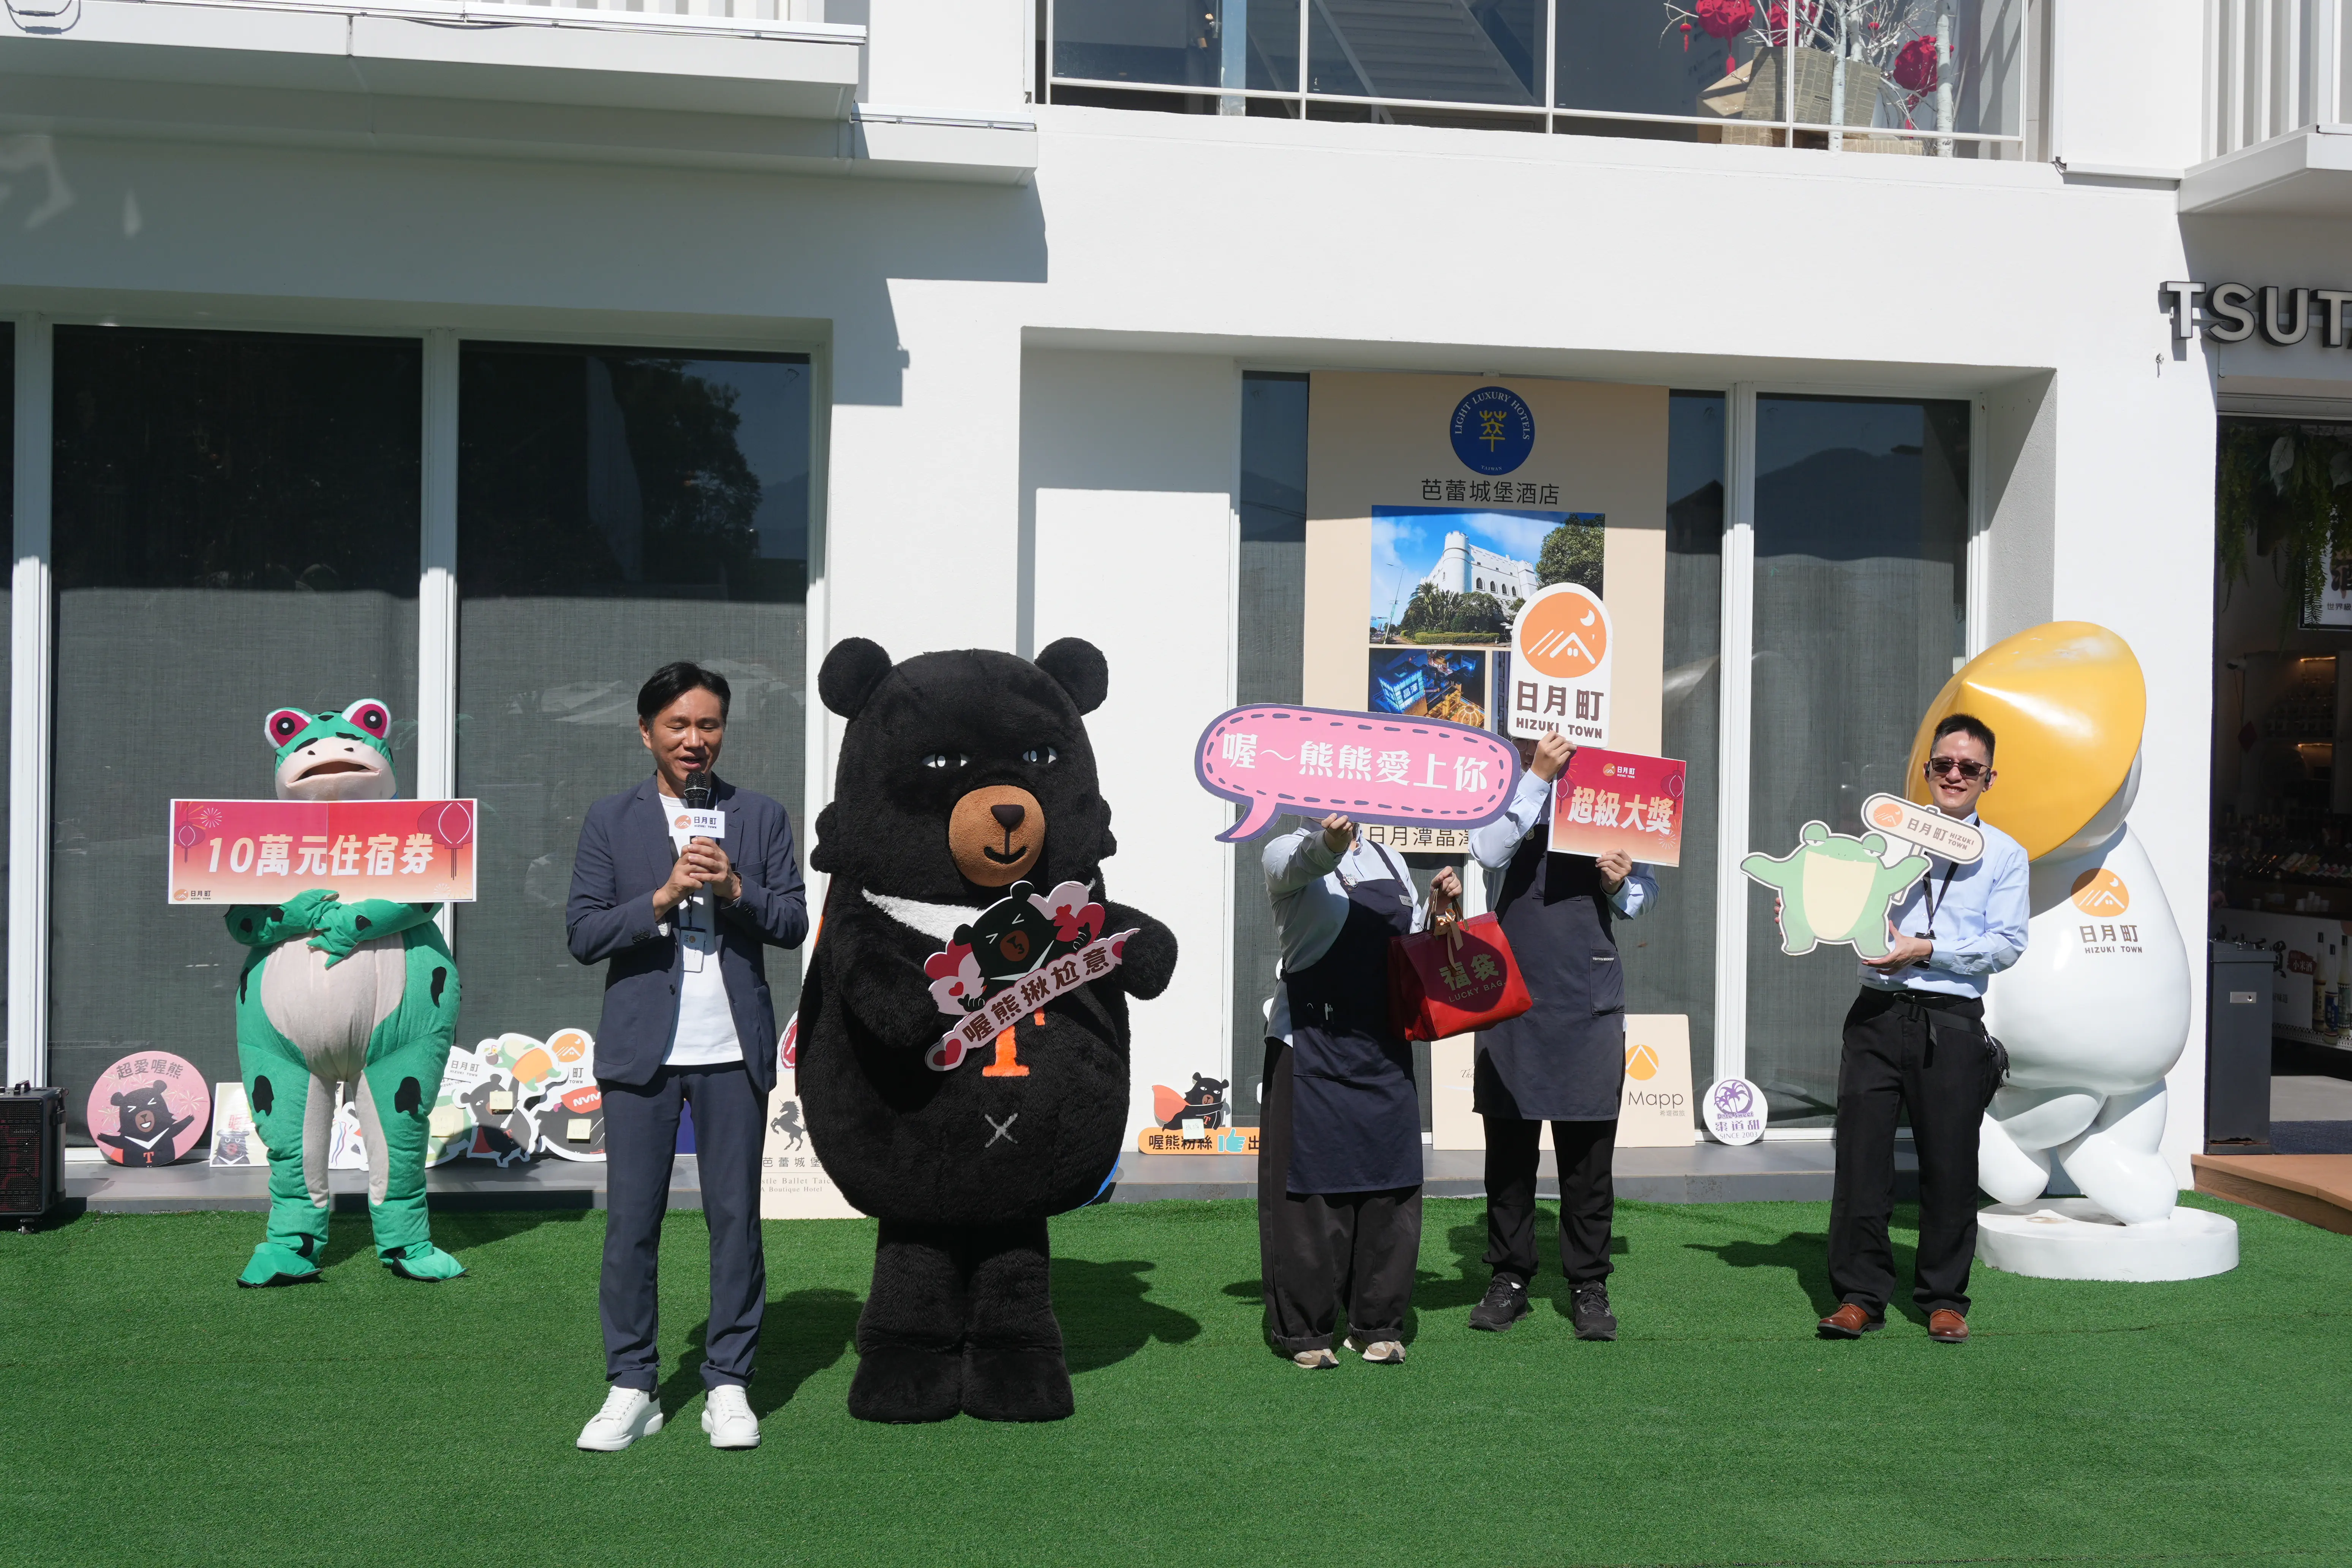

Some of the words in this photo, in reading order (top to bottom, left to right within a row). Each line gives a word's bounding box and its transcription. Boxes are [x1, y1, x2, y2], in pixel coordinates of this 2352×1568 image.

[2160, 281, 2352, 349] TSUT
[1455, 402, 1471, 434] LIGHT
[1472, 392, 1511, 404] LUXURY
[1511, 400, 1530, 440] HOTELS
[1422, 479, 1559, 505] 芭蕾城堡酒店
[1517, 681, 1604, 721] 日月町
[1516, 718, 1559, 733] HIZUKI
[1568, 724, 1602, 739] TOWN
[1617, 766, 1636, 775] 日月町
[1567, 786, 1674, 835] 超級大獎
[1907, 817, 1949, 841] 日月町
[1949, 832, 1974, 846] HIZUKI
[209, 833, 434, 876] 10萬元住宿券
[1948, 839, 1968, 850] TOWN
[2079, 925, 2138, 943] 日月町
[1439, 954, 1499, 991] 福袋
[962, 946, 1109, 1042] 喔熊揪尬意
[1449, 988, 1479, 1002] LUCKY
[116, 1059, 183, 1080] 超愛喔熊
[451, 1060, 480, 1072] 日月町
[1629, 1091, 1683, 1109] Mapp
[1149, 1135, 1212, 1150] 喔熊粉絲
[762, 1157, 821, 1167] 芭蕾城堡
